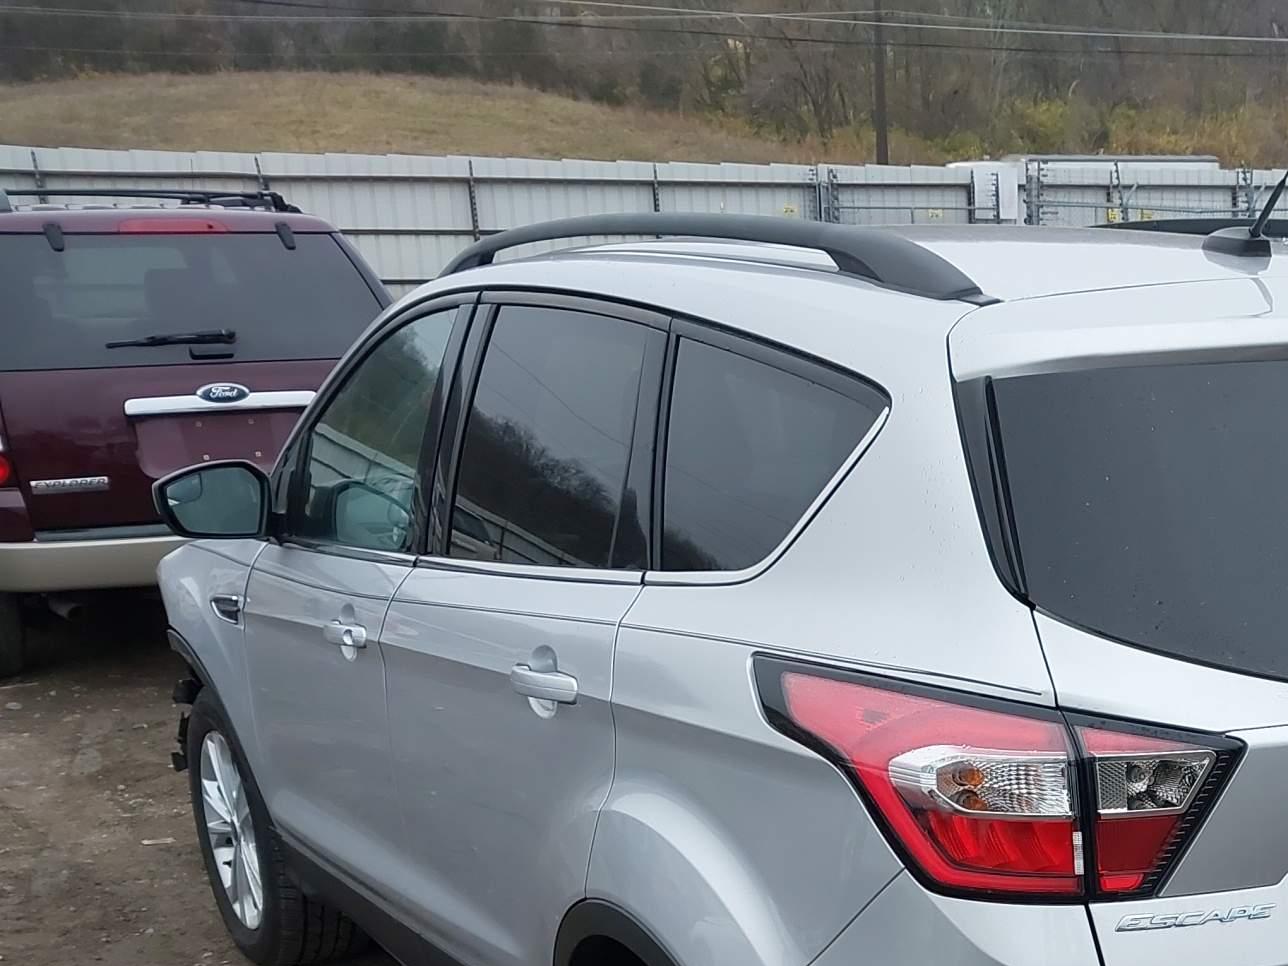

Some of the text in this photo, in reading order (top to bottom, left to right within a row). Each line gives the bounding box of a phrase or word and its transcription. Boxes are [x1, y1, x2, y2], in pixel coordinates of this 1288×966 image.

[209, 386, 238, 399] Ford
[33, 478, 106, 489] EXPLORER
[1114, 903, 1277, 932] ESCAPE
